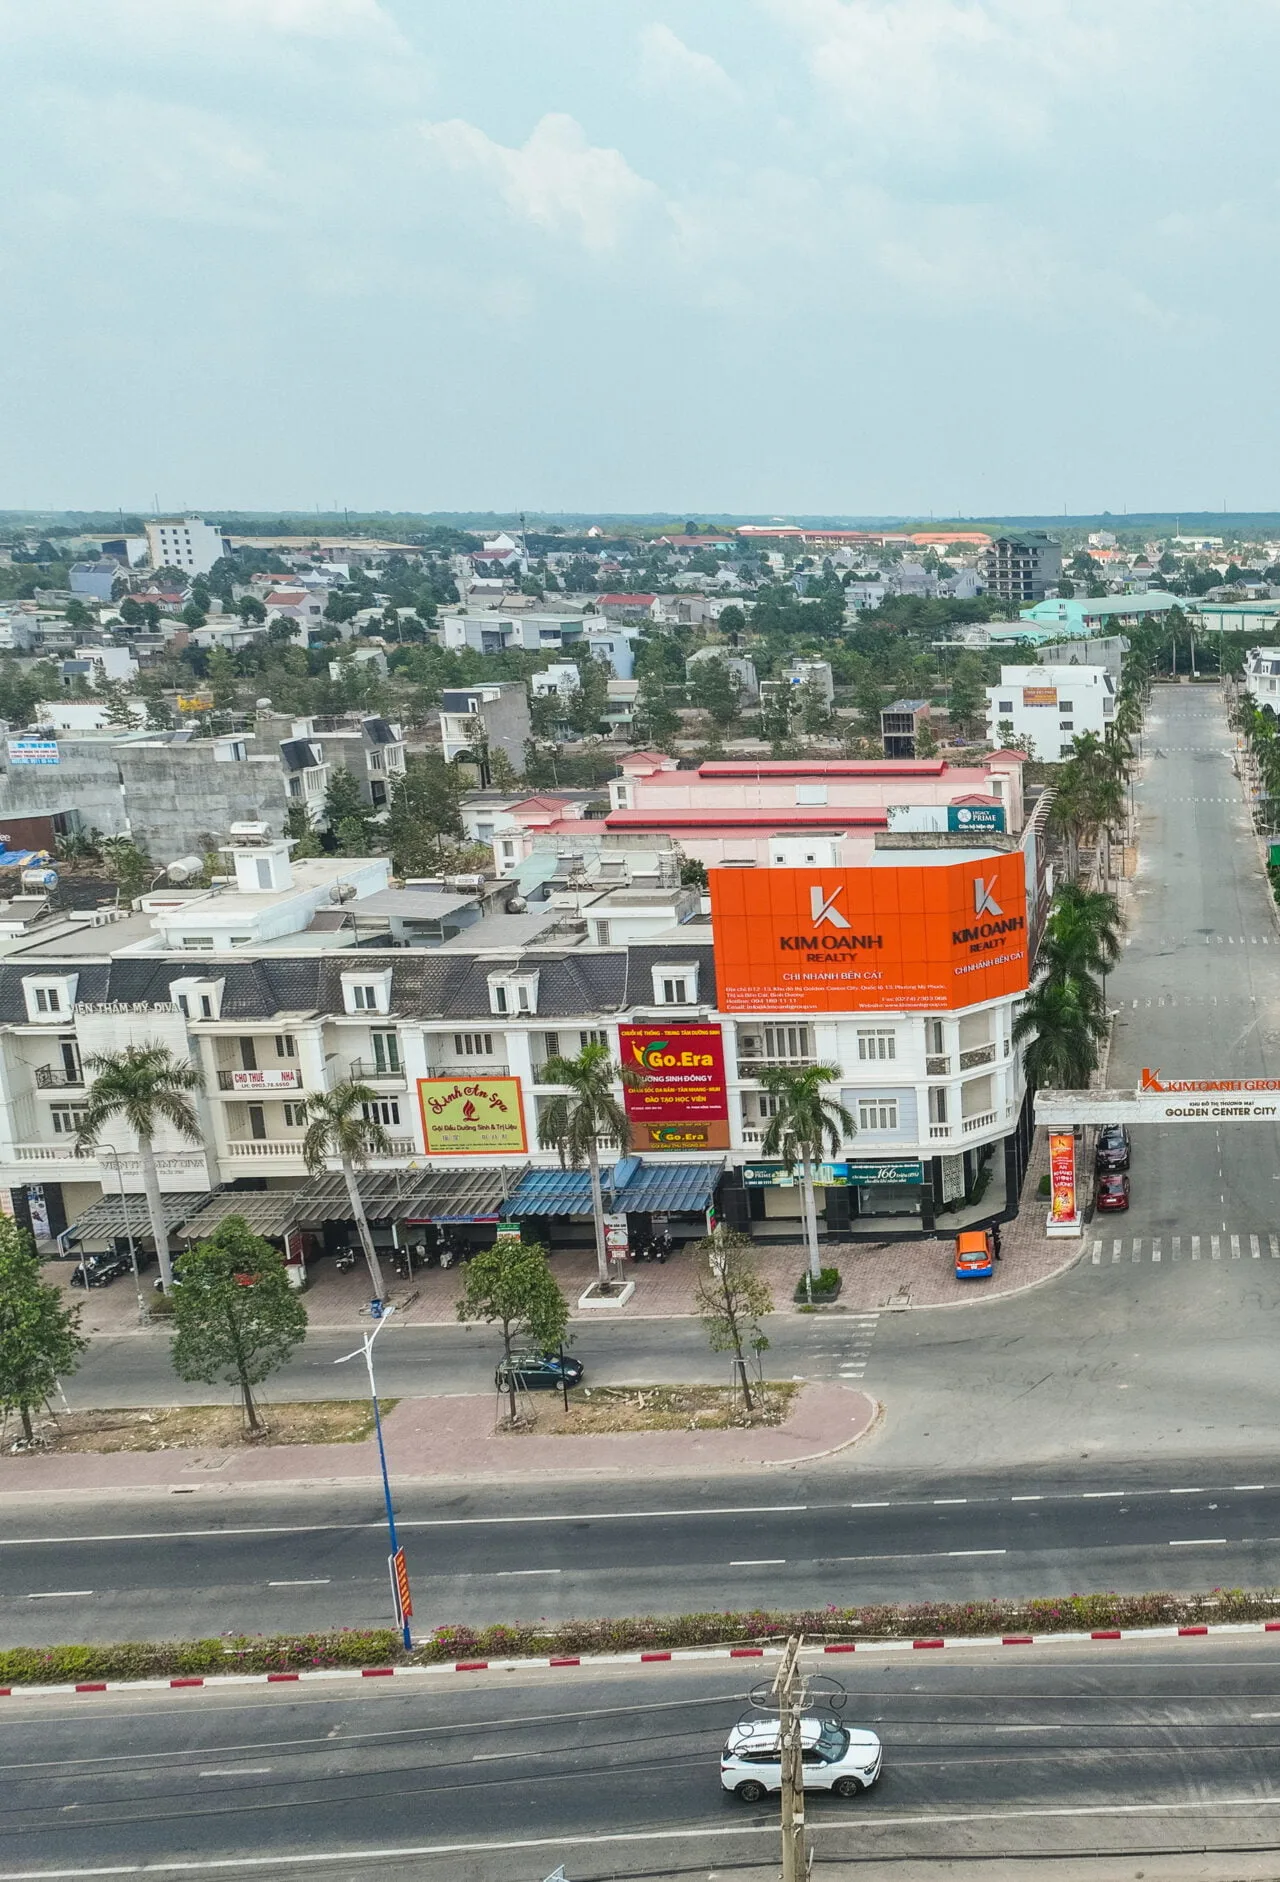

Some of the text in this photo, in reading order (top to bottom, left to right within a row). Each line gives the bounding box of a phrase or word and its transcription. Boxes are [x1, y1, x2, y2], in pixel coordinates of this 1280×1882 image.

[952, 916, 1025, 945] KIM OANH
[780, 935, 883, 951] KIM OANH
[970, 937, 1007, 953] REALTY
[806, 953, 858, 963] REALTY
[803, 971, 839, 980] NHÁNH
[863, 970, 883, 979] CÁT
[954, 966, 968, 975] CHI
[154, 1001, 181, 1013] DIVA
[649, 1051, 714, 1067] Go.Era
[235, 1073, 247, 1083] CHO
[636, 1074, 664, 1083] ƯỠNG
[683, 1074, 707, 1082] ĐÔNG
[1168, 1081, 1195, 1092] KIM
[1199, 1081, 1242, 1091] OANH
[489, 1093, 509, 1113] Spa
[660, 1096, 674, 1104] TẠO
[1165, 1107, 1277, 1117] GOLDEN CENTER CITY
[666, 1133, 704, 1141] Go.Era
[877, 1167, 897, 1179] 166
